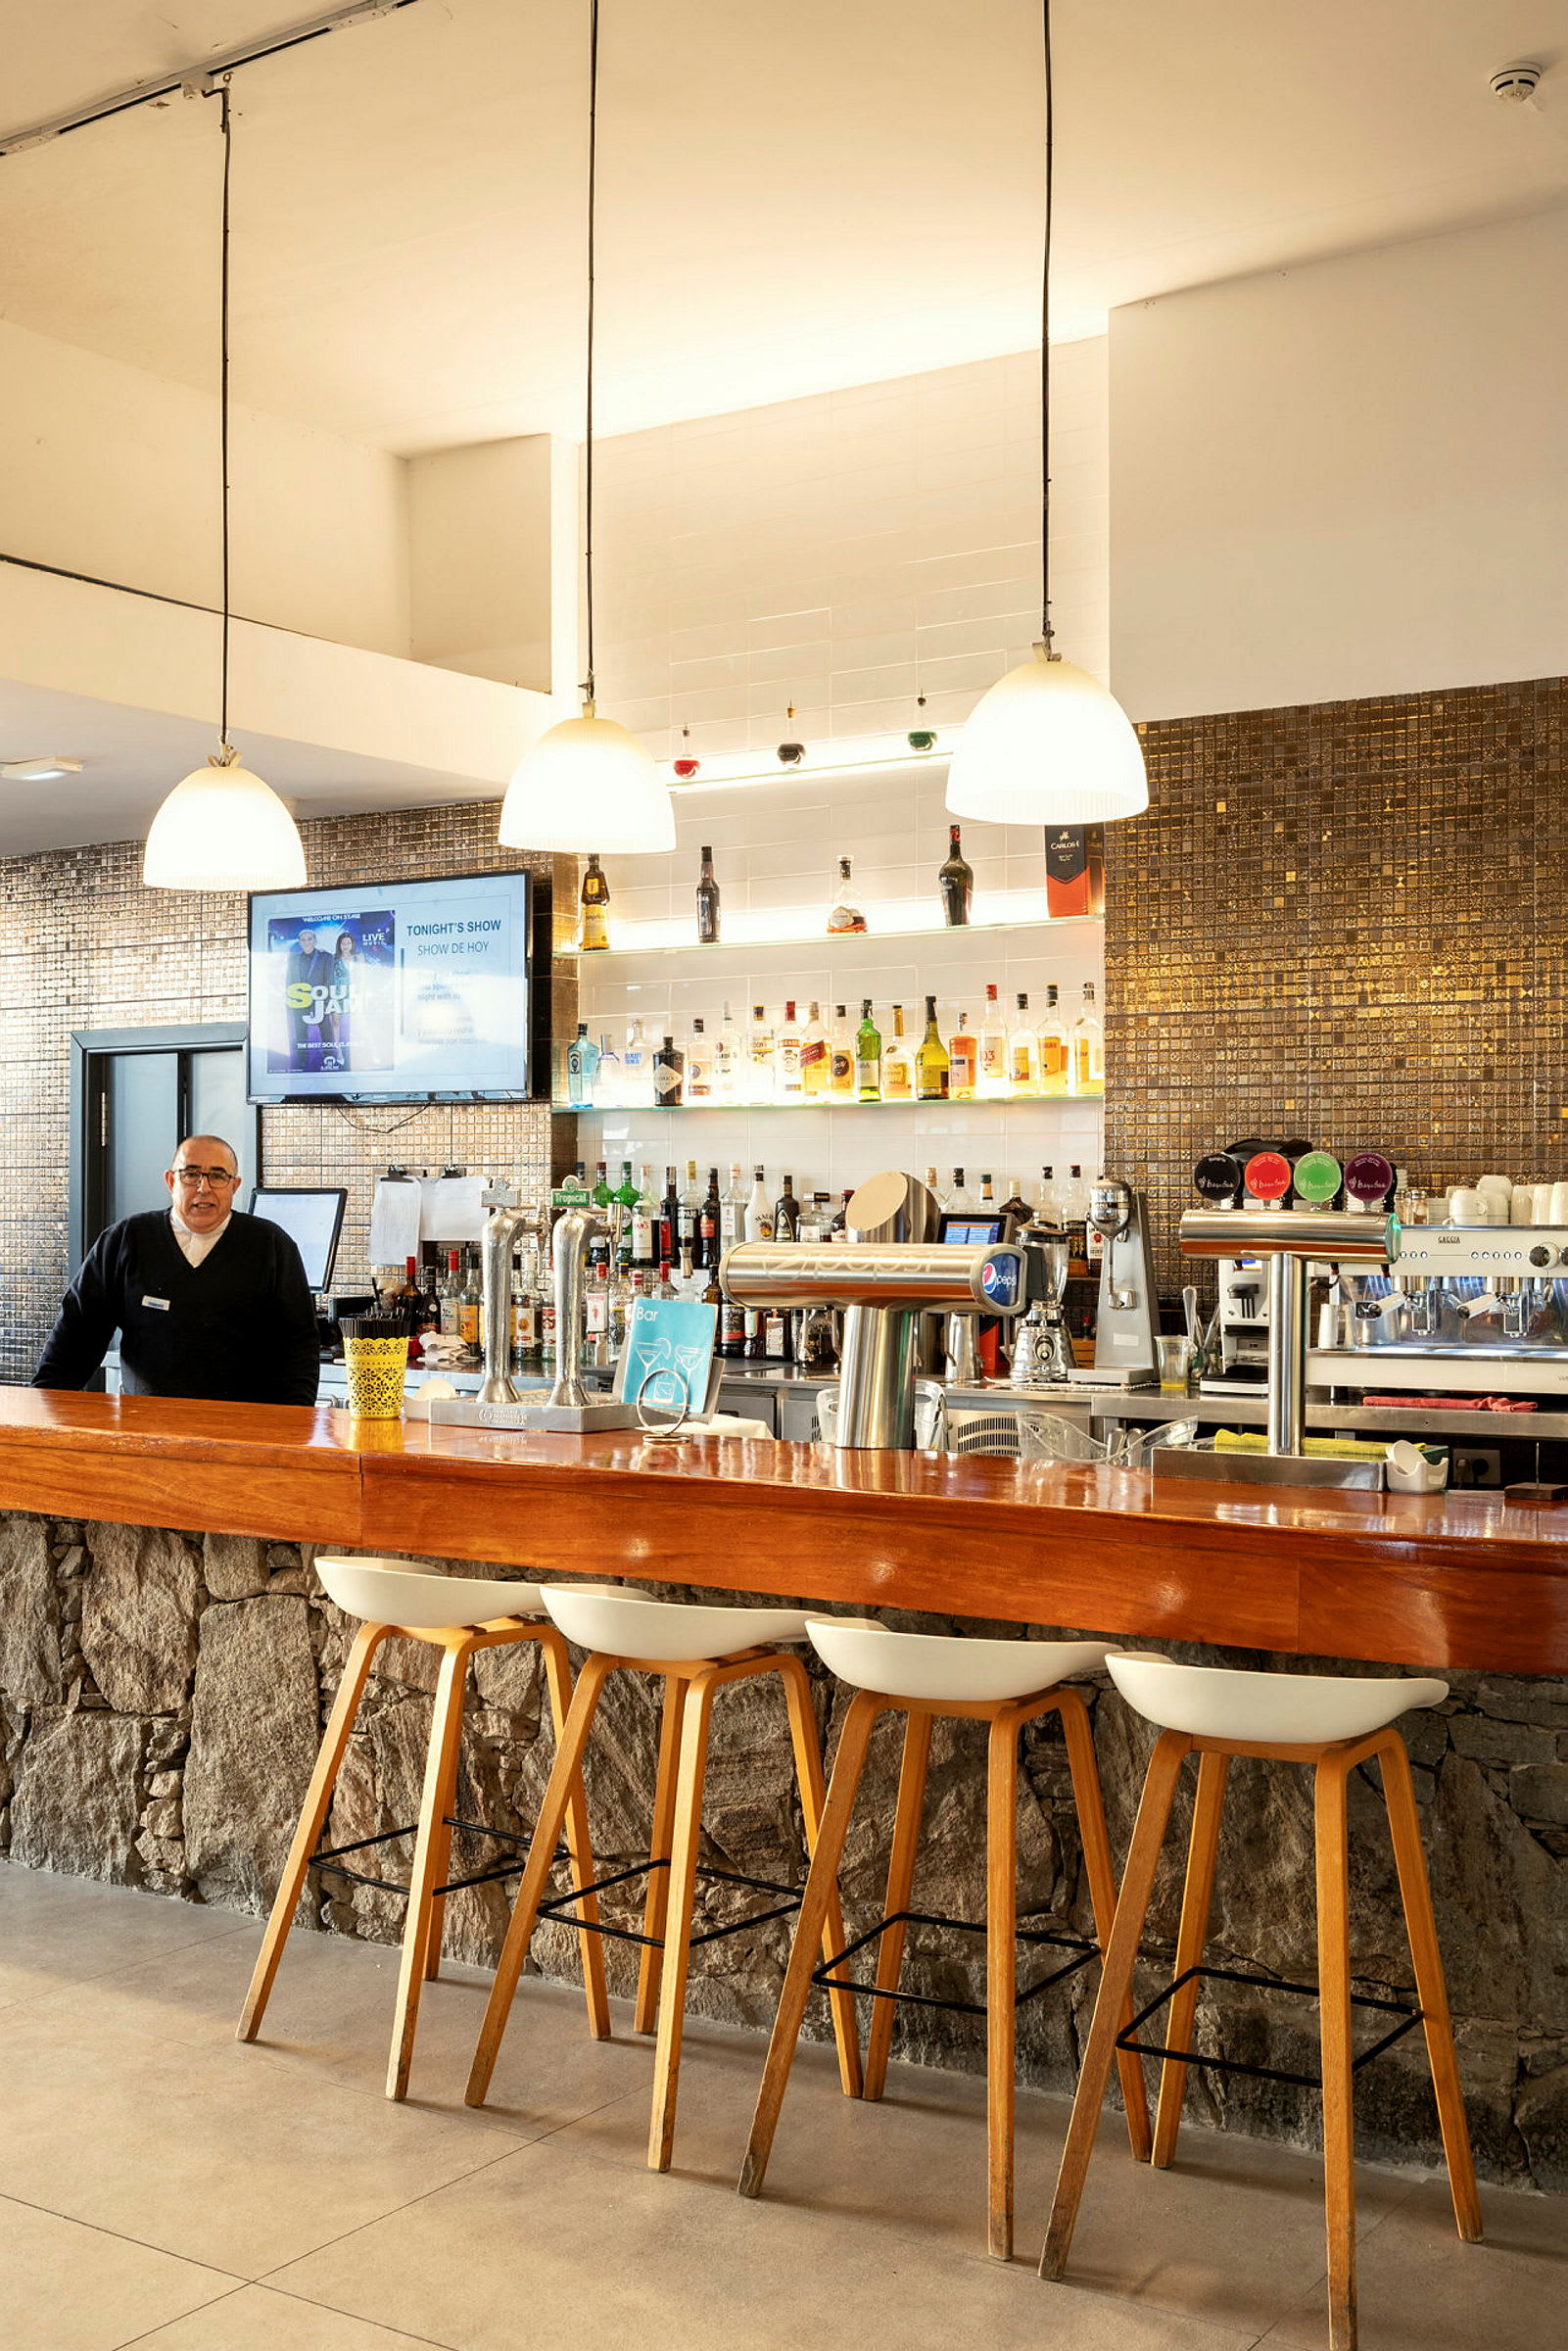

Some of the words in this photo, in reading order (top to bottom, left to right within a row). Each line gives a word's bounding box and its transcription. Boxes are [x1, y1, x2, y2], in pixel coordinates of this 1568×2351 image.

[406, 922, 464, 936] TONIGHT'S
[467, 919, 501, 933] SHOW
[362, 933, 386, 941] LIVE
[417, 943, 450, 956] SHOW
[451, 942, 464, 954] DE
[467, 940, 490, 953] HOY
[554, 1192, 587, 1204] Tropical
[637, 1306, 659, 1321] Bar
